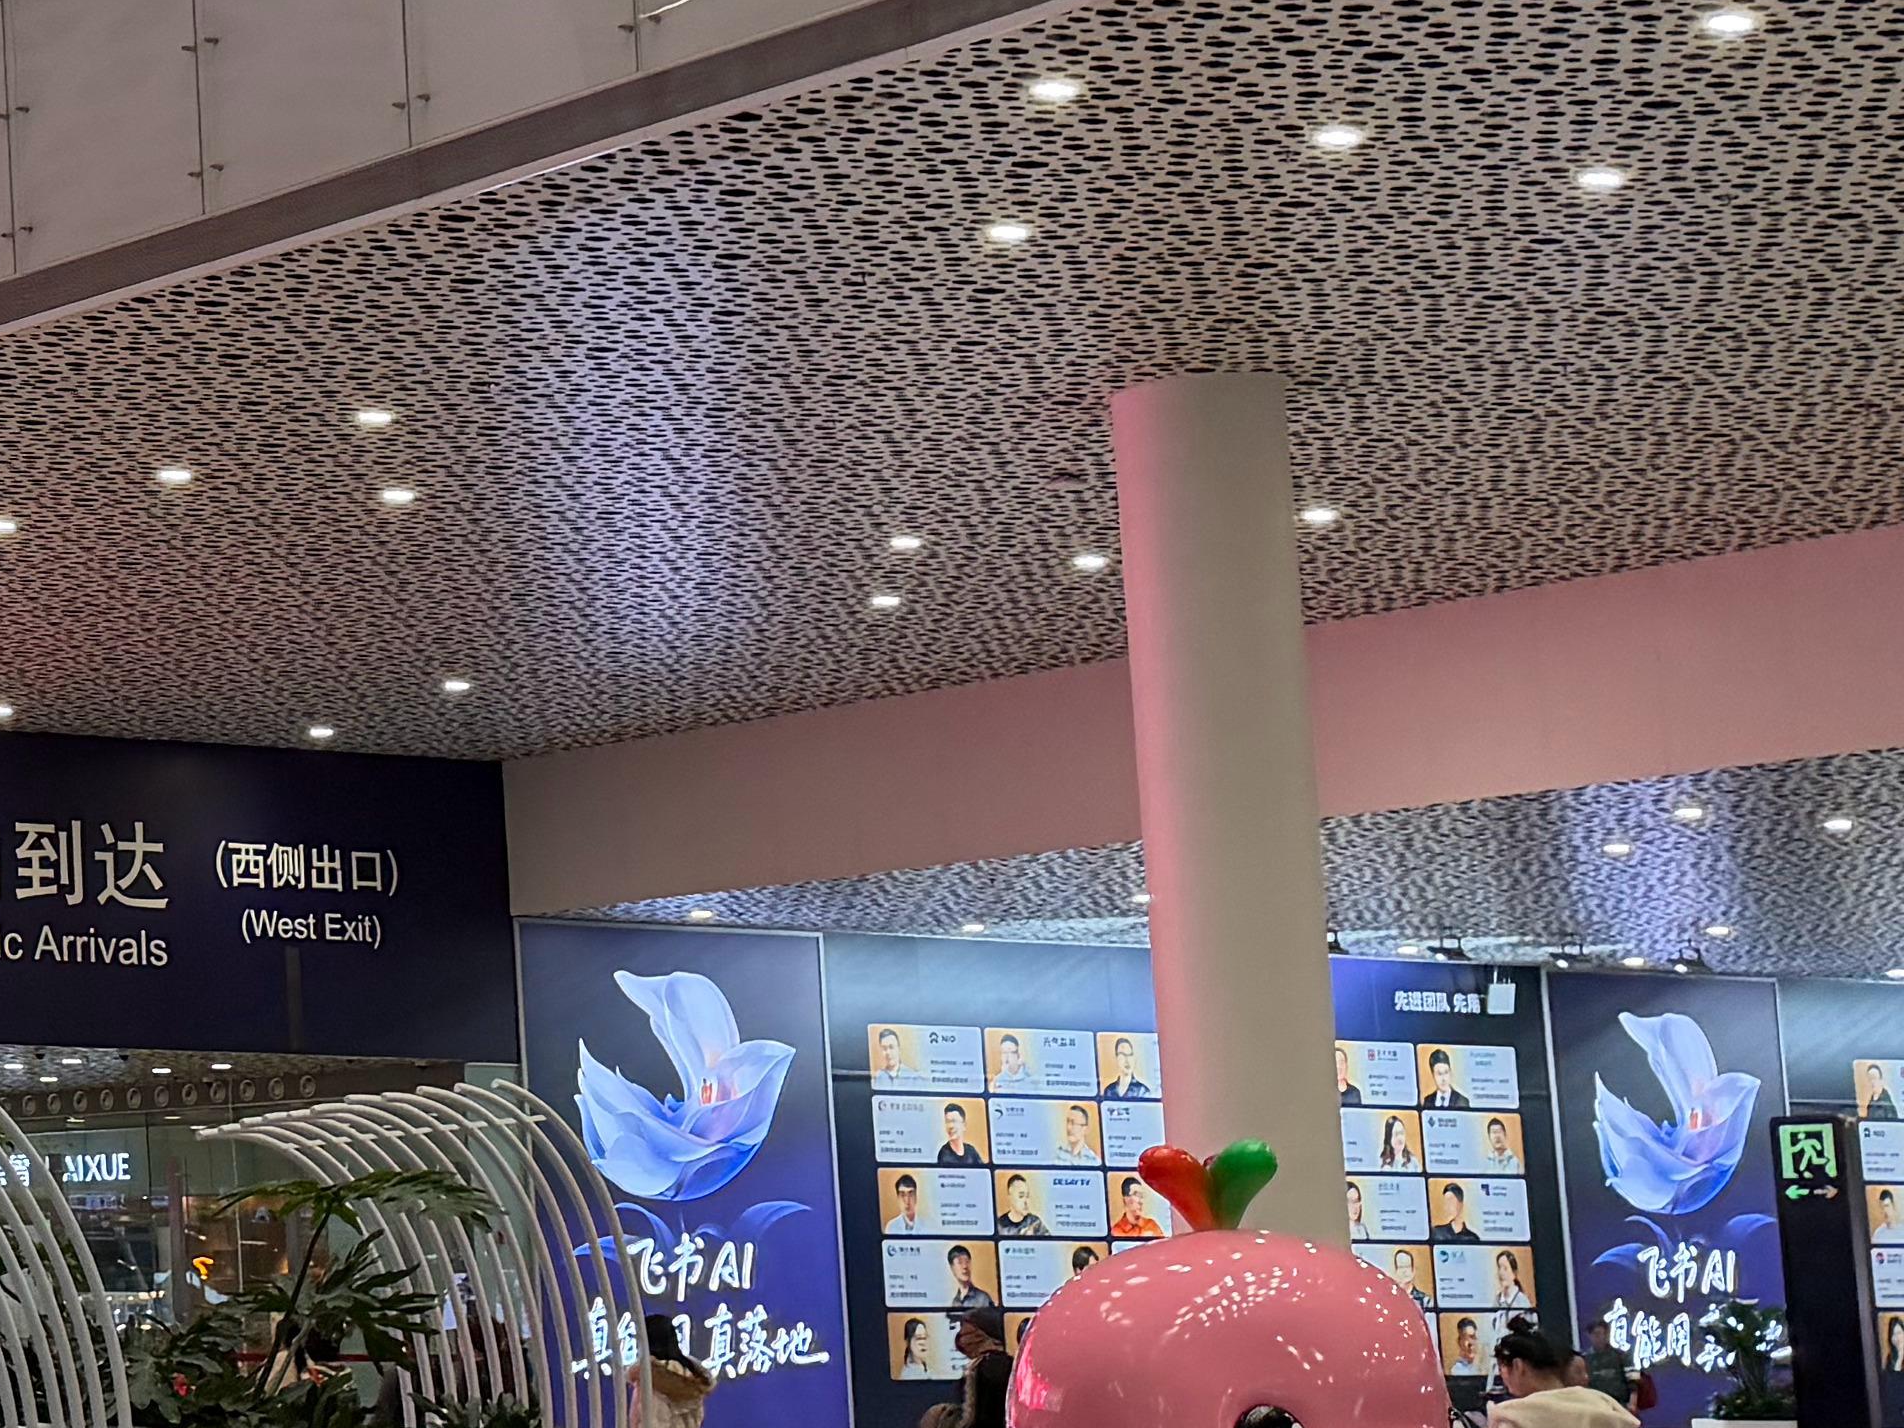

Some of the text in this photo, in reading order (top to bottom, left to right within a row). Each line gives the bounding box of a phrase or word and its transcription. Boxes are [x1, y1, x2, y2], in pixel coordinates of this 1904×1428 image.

[215, 839, 399, 897] (西侧出口)
[34, 925, 168, 966] Arrivals
[241, 907, 382, 950] (West Exit)
